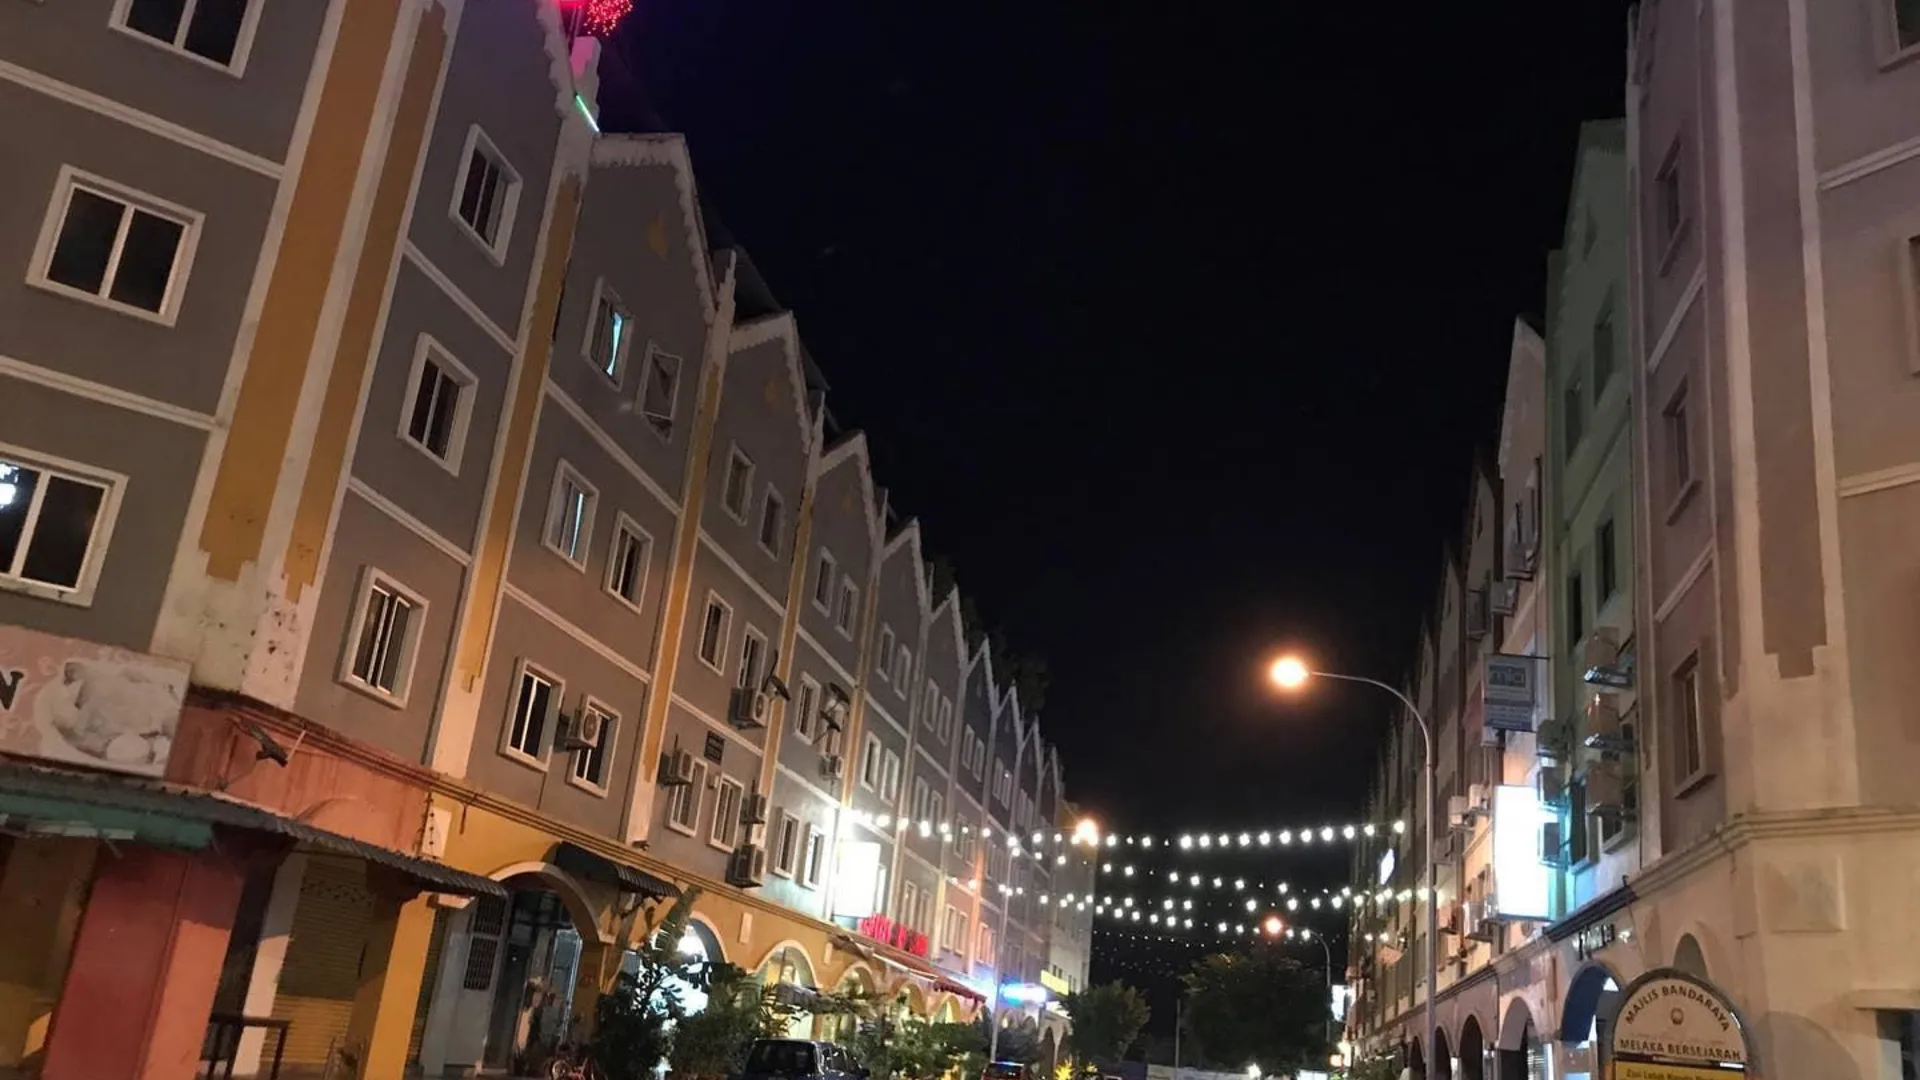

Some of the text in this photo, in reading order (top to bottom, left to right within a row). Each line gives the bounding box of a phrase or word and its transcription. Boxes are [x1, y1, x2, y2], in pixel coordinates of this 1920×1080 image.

[1625, 985, 1730, 1032] MAJLIS BANDARAYA
[1620, 1039, 1740, 1060] MELAKA BERSEJARAH
